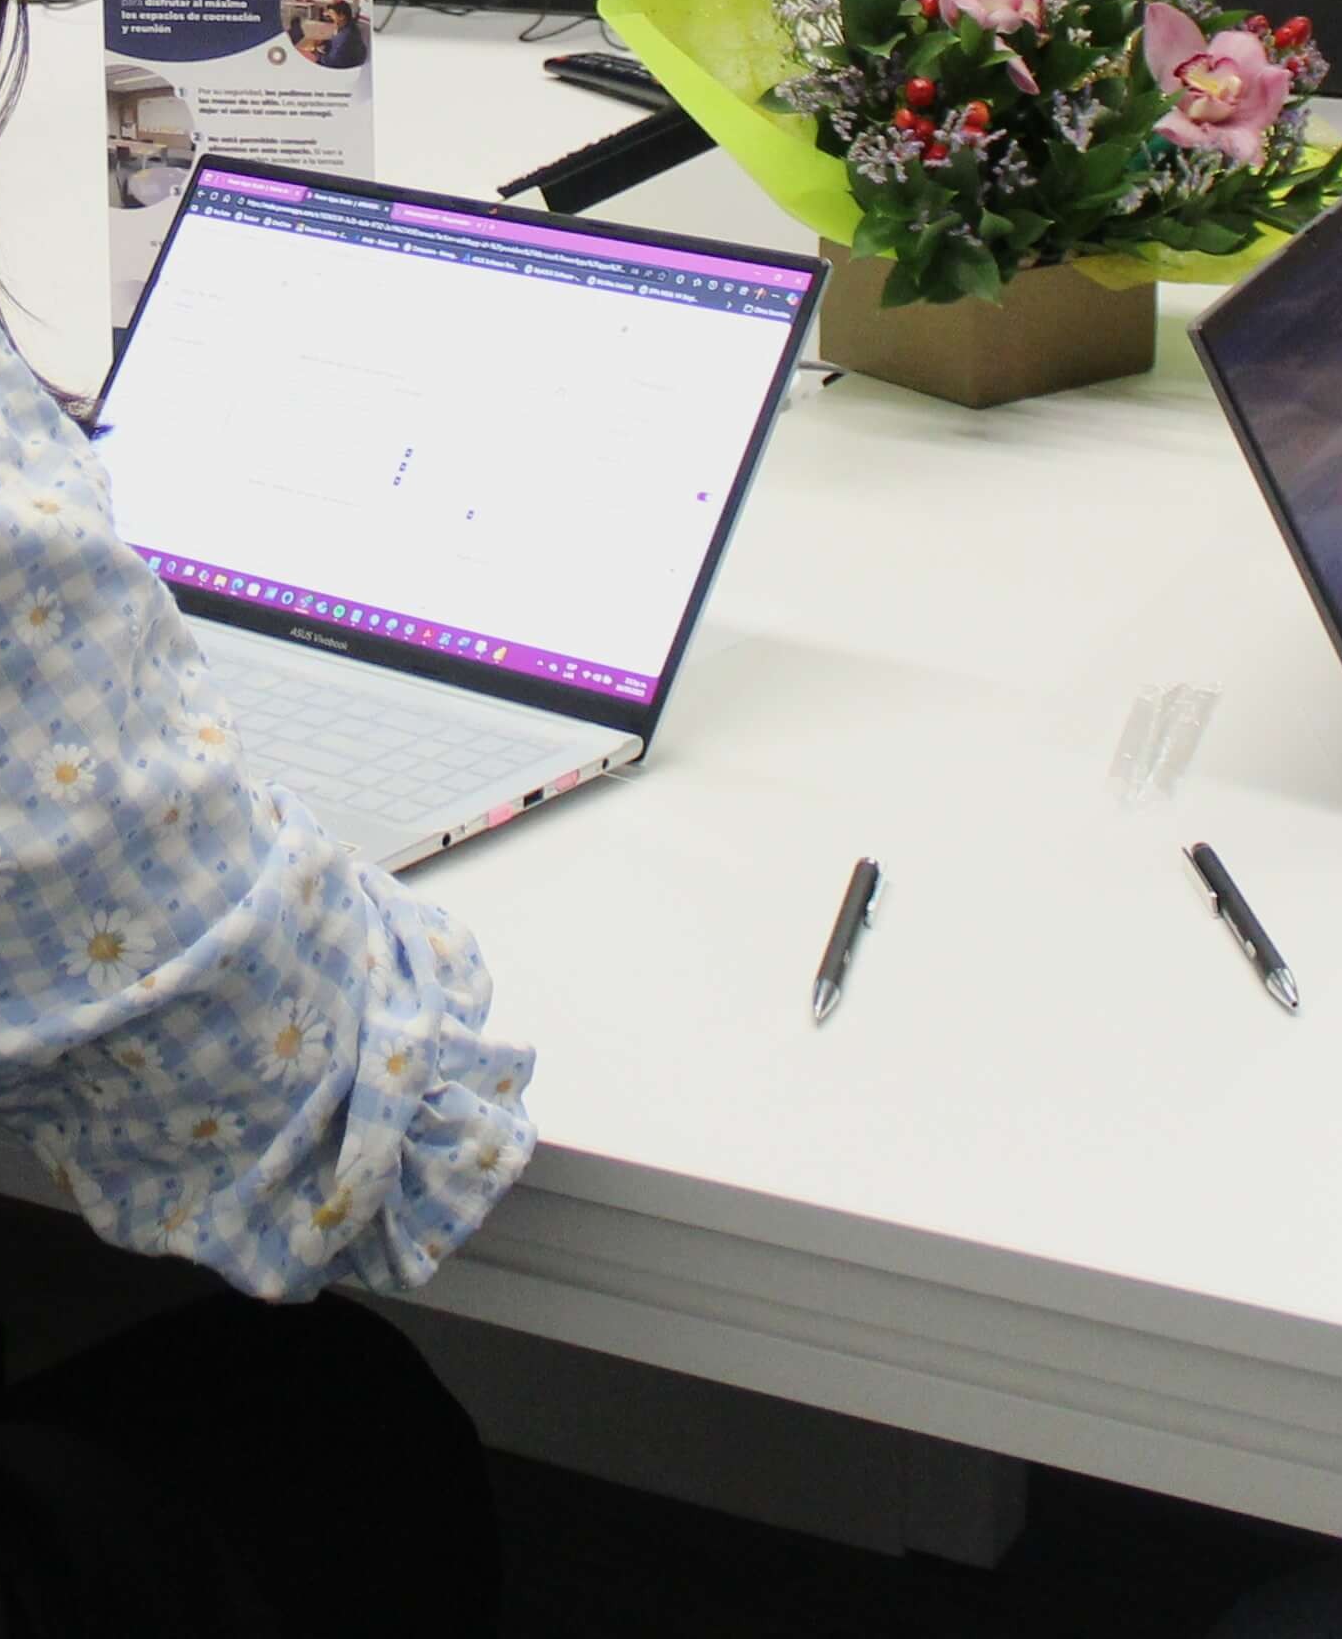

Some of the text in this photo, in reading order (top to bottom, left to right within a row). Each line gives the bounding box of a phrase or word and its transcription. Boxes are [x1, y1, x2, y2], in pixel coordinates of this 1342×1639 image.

[121, 10, 261, 22] los espacios de cocreación
[121, 23, 172, 35] y reunión
